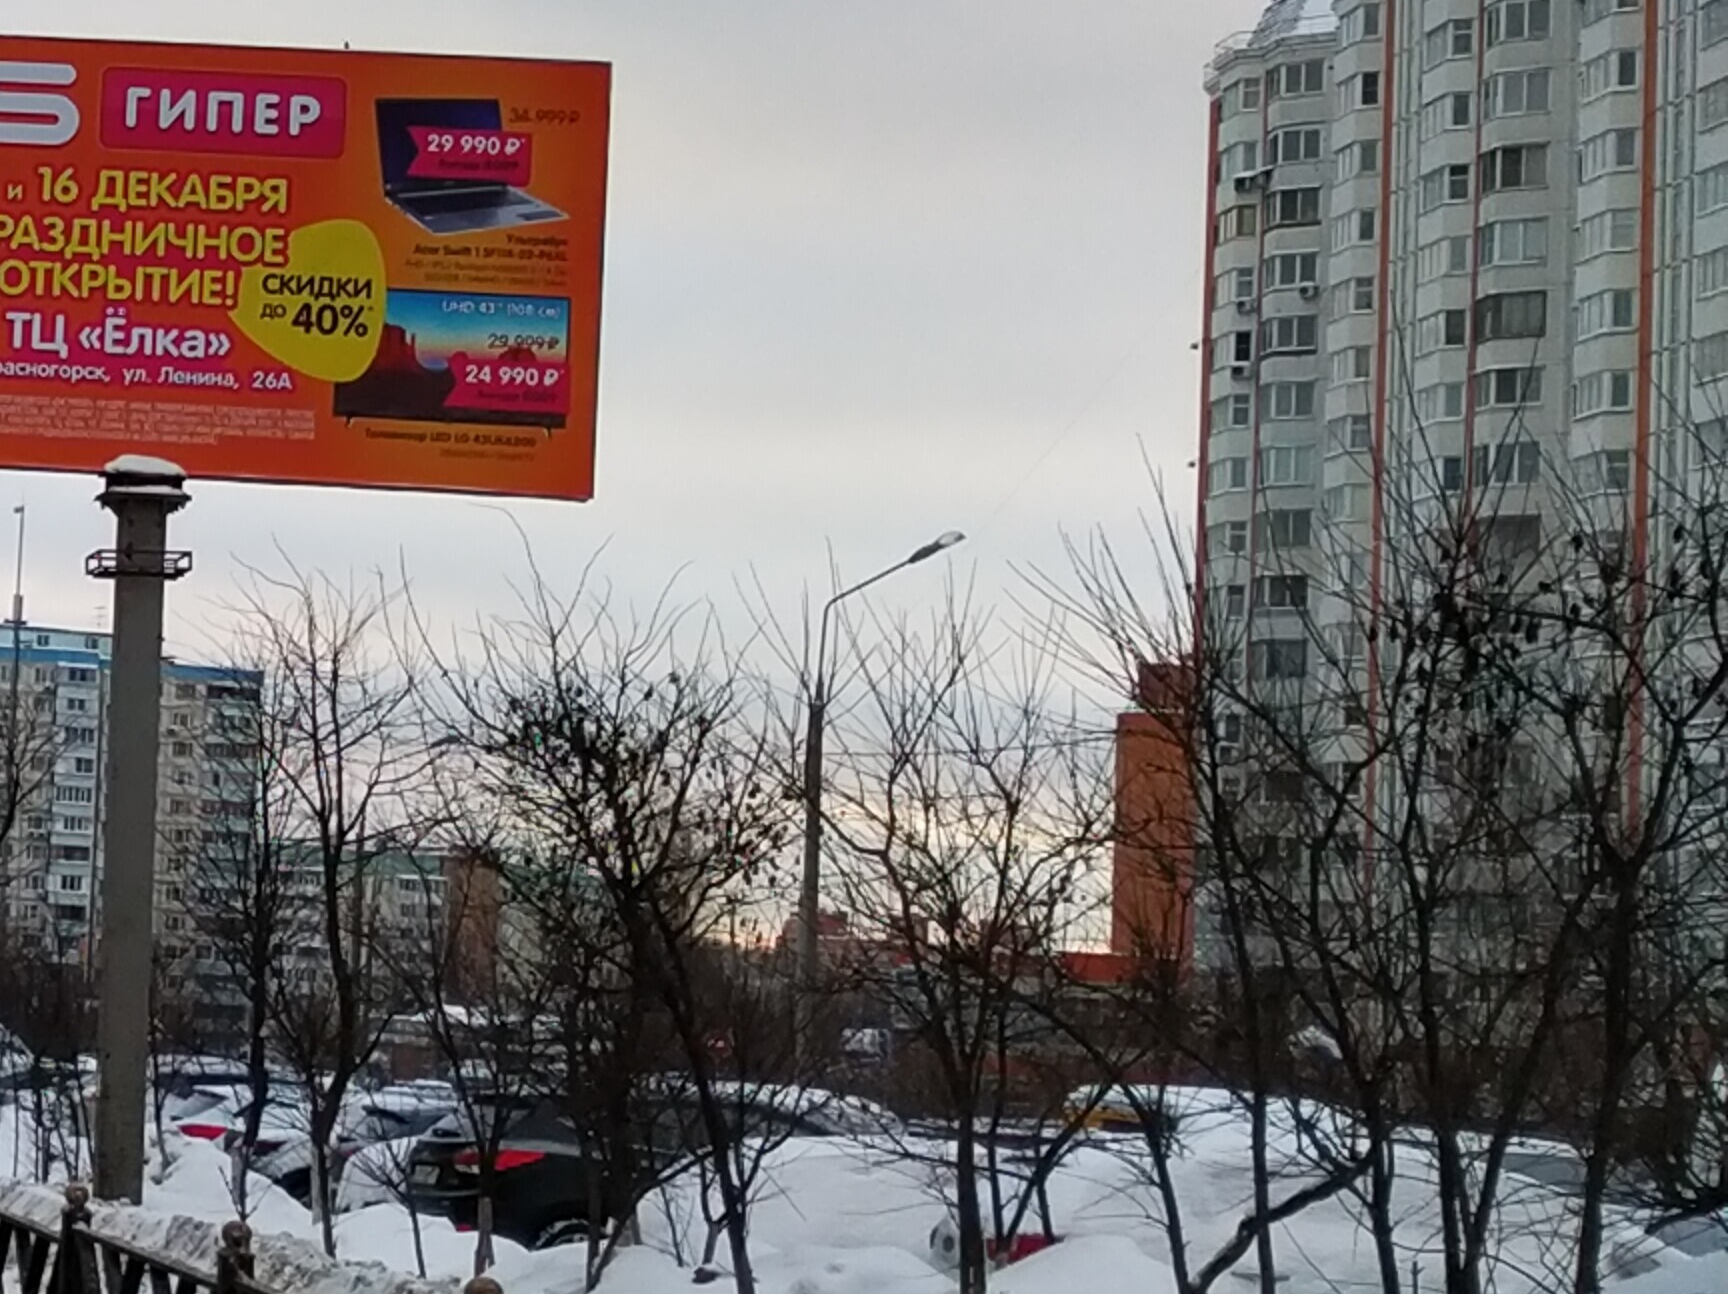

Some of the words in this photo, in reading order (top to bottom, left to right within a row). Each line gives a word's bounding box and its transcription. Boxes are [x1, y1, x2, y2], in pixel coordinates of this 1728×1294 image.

[124, 86, 322, 137] ГИПЕР
[427, 134, 454, 152] 29
[460, 136, 501, 155] 990
[6, 183, 24, 201] и
[37, 167, 80, 204] 16
[91, 169, 289, 214] ДЕКАБРЯ
[260, 272, 373, 301] СКИДКИ
[442, 300, 476, 313] UHD
[5, 311, 69, 360] ТЦ
[79, 307, 231, 358] «Ёлка»
[123, 369, 152, 387] ул.
[158, 367, 241, 391] Ленина,
[465, 365, 491, 383] 24
[499, 367, 539, 386] 990
